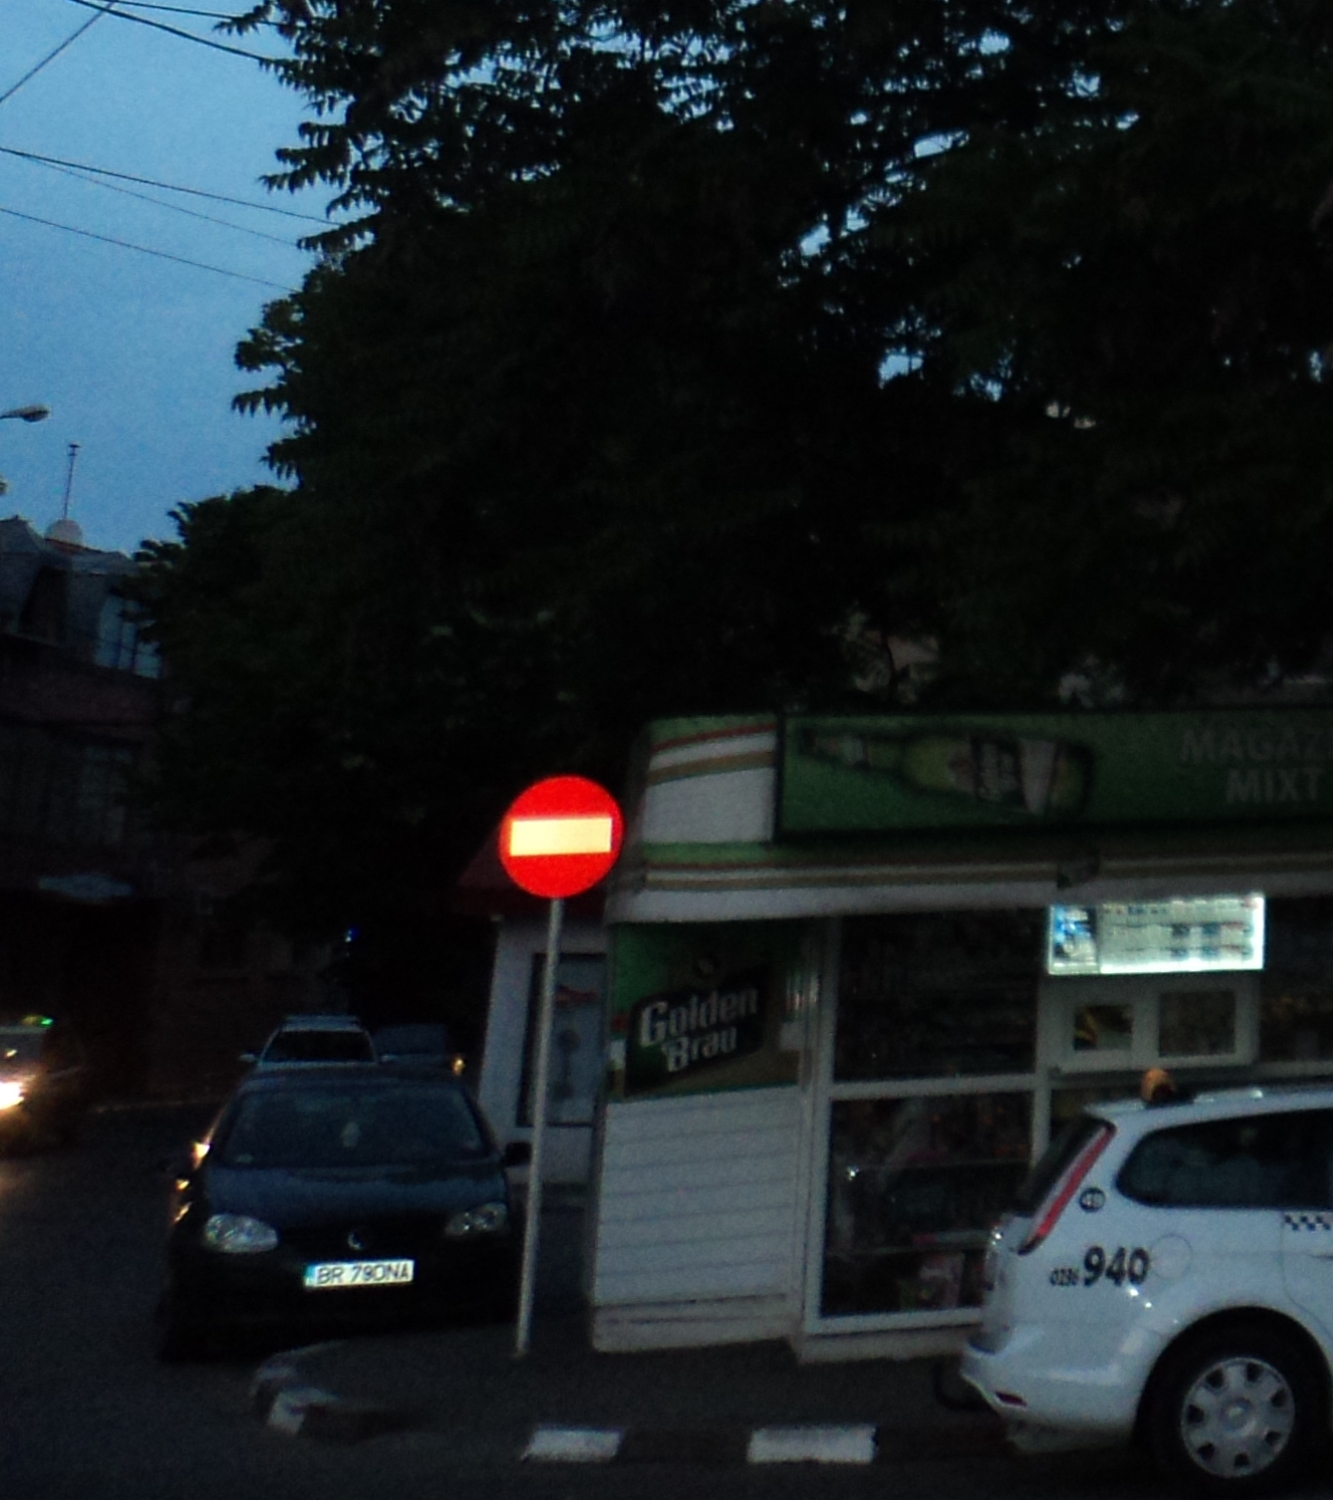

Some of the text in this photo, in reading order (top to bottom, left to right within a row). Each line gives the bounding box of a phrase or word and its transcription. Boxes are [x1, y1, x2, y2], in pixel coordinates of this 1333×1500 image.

[1225, 765, 1325, 804] MIXT
[638, 986, 759, 1048] Golden
[316, 1266, 343, 1284] BR
[1084, 1245, 1149, 1287] 940
